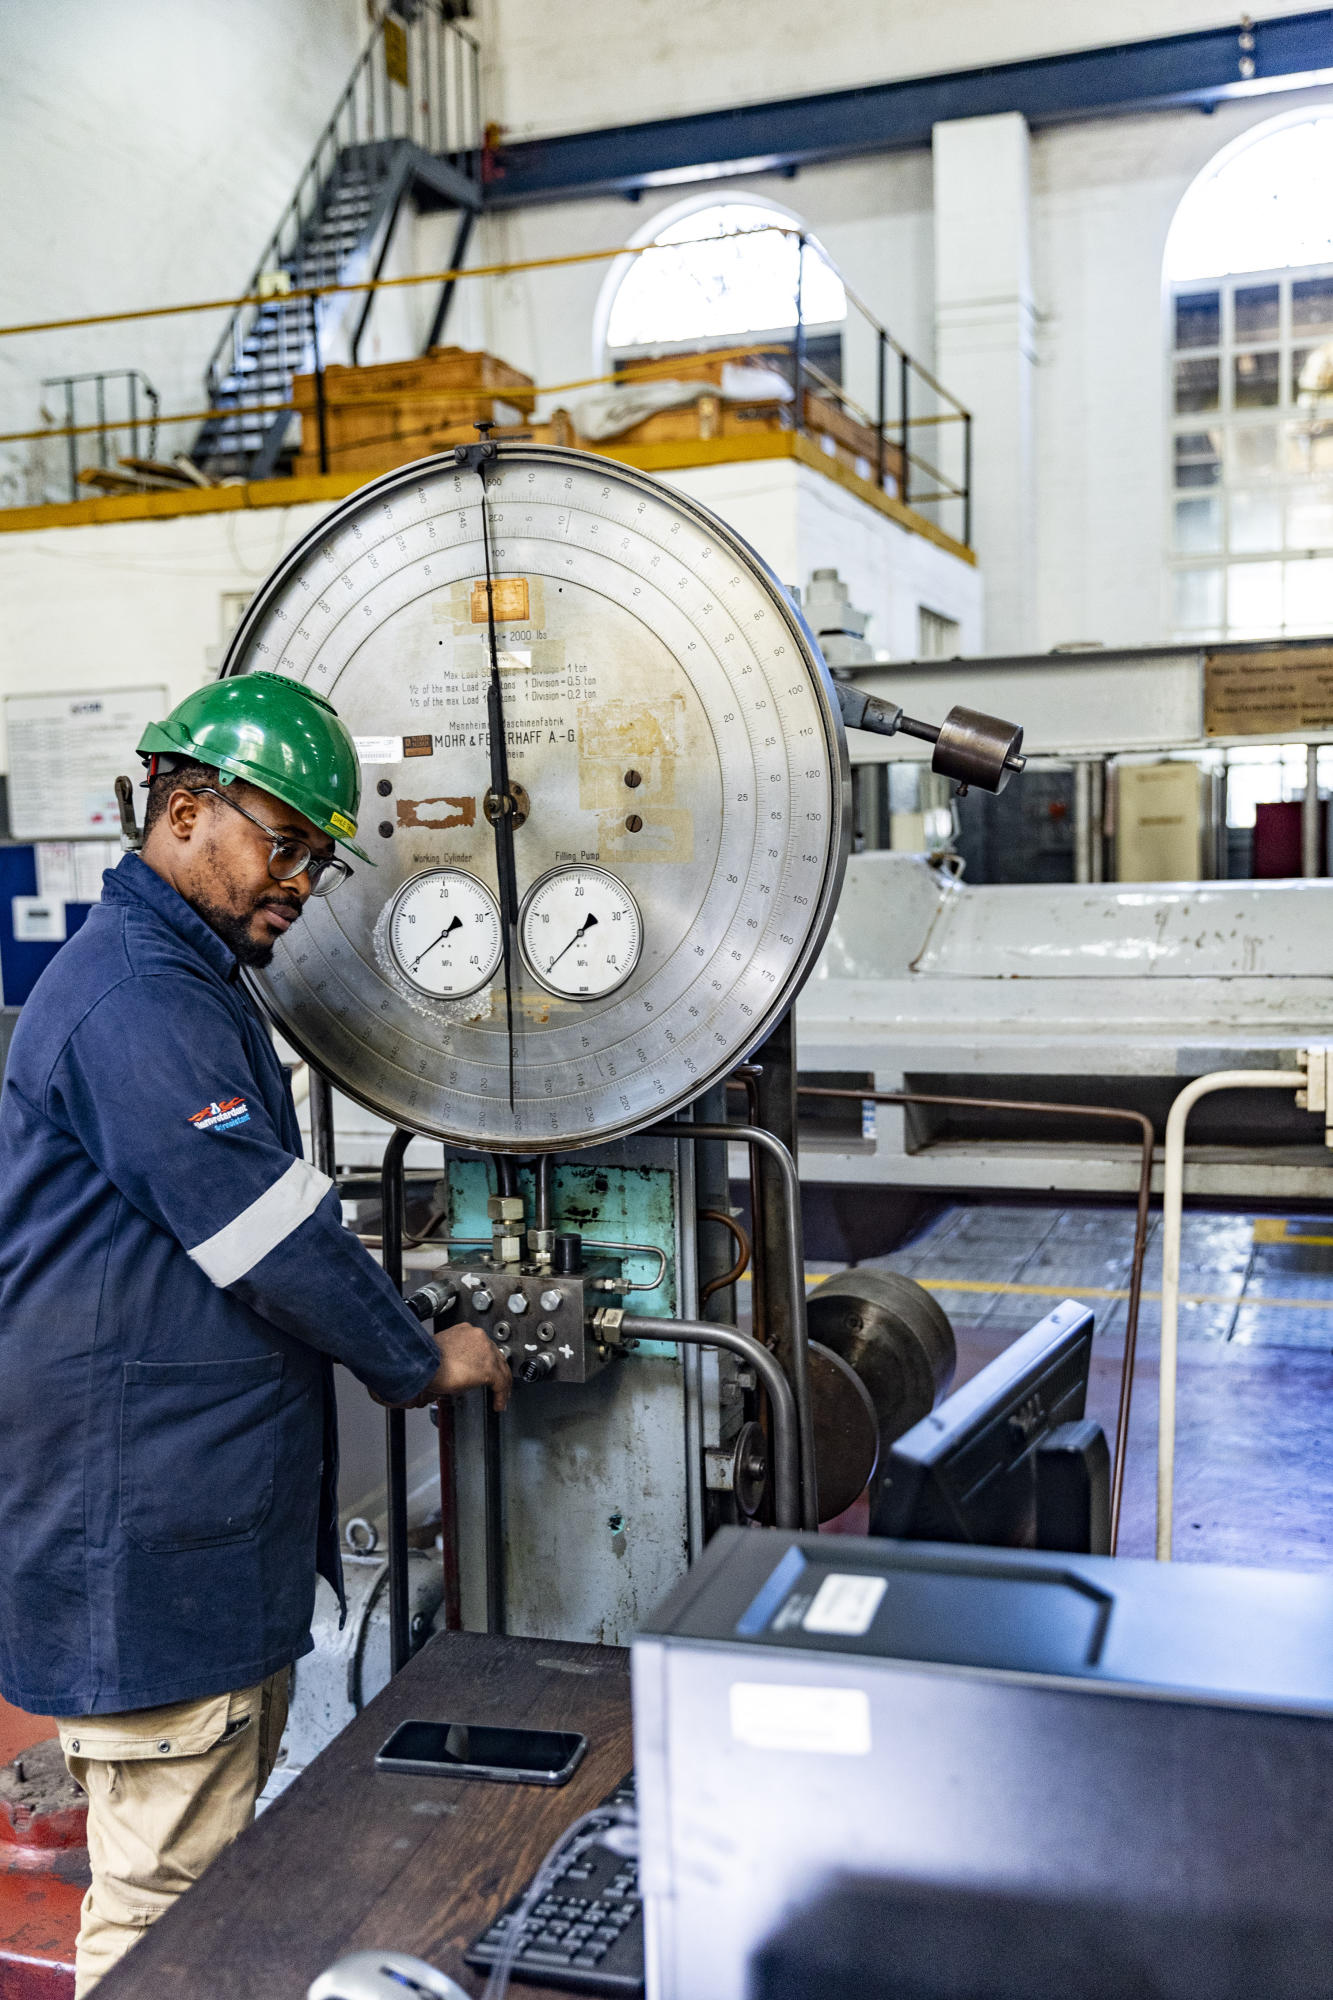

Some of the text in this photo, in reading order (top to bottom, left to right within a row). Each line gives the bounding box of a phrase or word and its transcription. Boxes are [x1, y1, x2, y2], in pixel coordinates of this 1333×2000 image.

[487, 478, 502, 486] 500
[528, 473, 536, 483] 10
[564, 478, 573, 489] 20
[418, 487, 427, 504] 480
[602, 488, 611, 499] 30
[383, 504, 393, 520] 470
[637, 502, 646, 514] 40
[558, 516, 565, 526] 10
[352, 522, 362, 540] 460
[426, 522, 436, 538] 240
[590, 524, 598, 534] 15
[670, 522, 680, 534] 50
[621, 538, 630, 549] 20
[322, 548, 334, 563] 450
[702, 547, 712, 559] 60
[368, 554, 379, 569] 230
[651, 556, 660, 567] 25
[424, 564, 432, 576] 95
[297, 576, 310, 591] 440
[342, 575, 354, 590] 225
[678, 578, 688, 589] 30
[728, 576, 741, 588] 70
[633, 588, 641, 596] 10
[318, 600, 330, 614] 220
[363, 606, 372, 616] 90
[702, 604, 712, 614] 35
[274, 608, 288, 620] 430
[754, 609, 765, 621] 80
[298, 628, 311, 640] 215
[510, 630, 532, 641] 2000
[536, 629, 547, 640] lbs
[724, 633, 734, 644] 40
[256, 642, 270, 654] 420
[688, 642, 696, 652] 15
[774, 646, 785, 657] 90
[282, 658, 294, 669] 210
[318, 664, 328, 674] 85
[462, 669, 478, 680] Load
[574, 664, 588, 672] ton
[742, 666, 752, 675] 45
[422, 684, 428, 694] of
[432, 683, 443, 693] the
[462, 682, 479, 692] Load
[532, 678, 560, 688] Division
[567, 676, 580, 686] 0.5
[584, 676, 596, 686] ton
[788, 684, 804, 696] 100
[424, 697, 430, 707] of
[433, 696, 443, 706] the
[462, 695, 479, 705] Load
[532, 691, 560, 701] Division
[567, 689, 580, 700] 0.2
[584, 690, 596, 699] ton
[756, 701, 766, 710] 50
[724, 713, 734, 722] 20
[799, 728, 814, 736] 110
[434, 734, 466, 748] MOHR
[470, 736, 476, 746] &
[766, 737, 776, 746] 55
[805, 770, 820, 778] 120
[770, 812, 782, 820] 65
[806, 813, 822, 821] 130
[413, 853, 472, 864] Working Cylinder
[556, 851, 600, 862] Filling Pump
[768, 848, 778, 858] 70
[802, 854, 818, 864] 140
[726, 874, 738, 884] 30
[440, 889, 448, 898] 20
[575, 887, 584, 896] 20
[760, 885, 770, 894] 75
[792, 895, 808, 906] 150
[409, 915, 416, 924] 10
[475, 914, 484, 922] 30
[542, 914, 550, 923] 10
[612, 912, 621, 920] 30
[746, 919, 758, 928] 80
[779, 934, 794, 945] 160
[694, 946, 704, 956] 35
[731, 950, 741, 960] 85
[470, 956, 478, 964] 40
[550, 956, 554, 964] 0
[607, 955, 616, 964] 40
[762, 969, 776, 982] 170
[712, 980, 722, 990] 90
[644, 1002, 653, 1012] 40
[688, 1006, 699, 1016] 95
[740, 1003, 752, 1016] 180
[664, 1029, 676, 1044] 100
[714, 1032, 726, 1046] 190
[636, 1048, 648, 1062] 105
[418, 1060, 427, 1074] 140
[608, 1062, 616, 1076] 110
[684, 1058, 698, 1074] 200
[450, 1071, 458, 1084] 135
[544, 1080, 552, 1094] 120
[653, 1080, 666, 1094] 210
[620, 1096, 631, 1111] 220
[584, 1106, 595, 1122] 230
